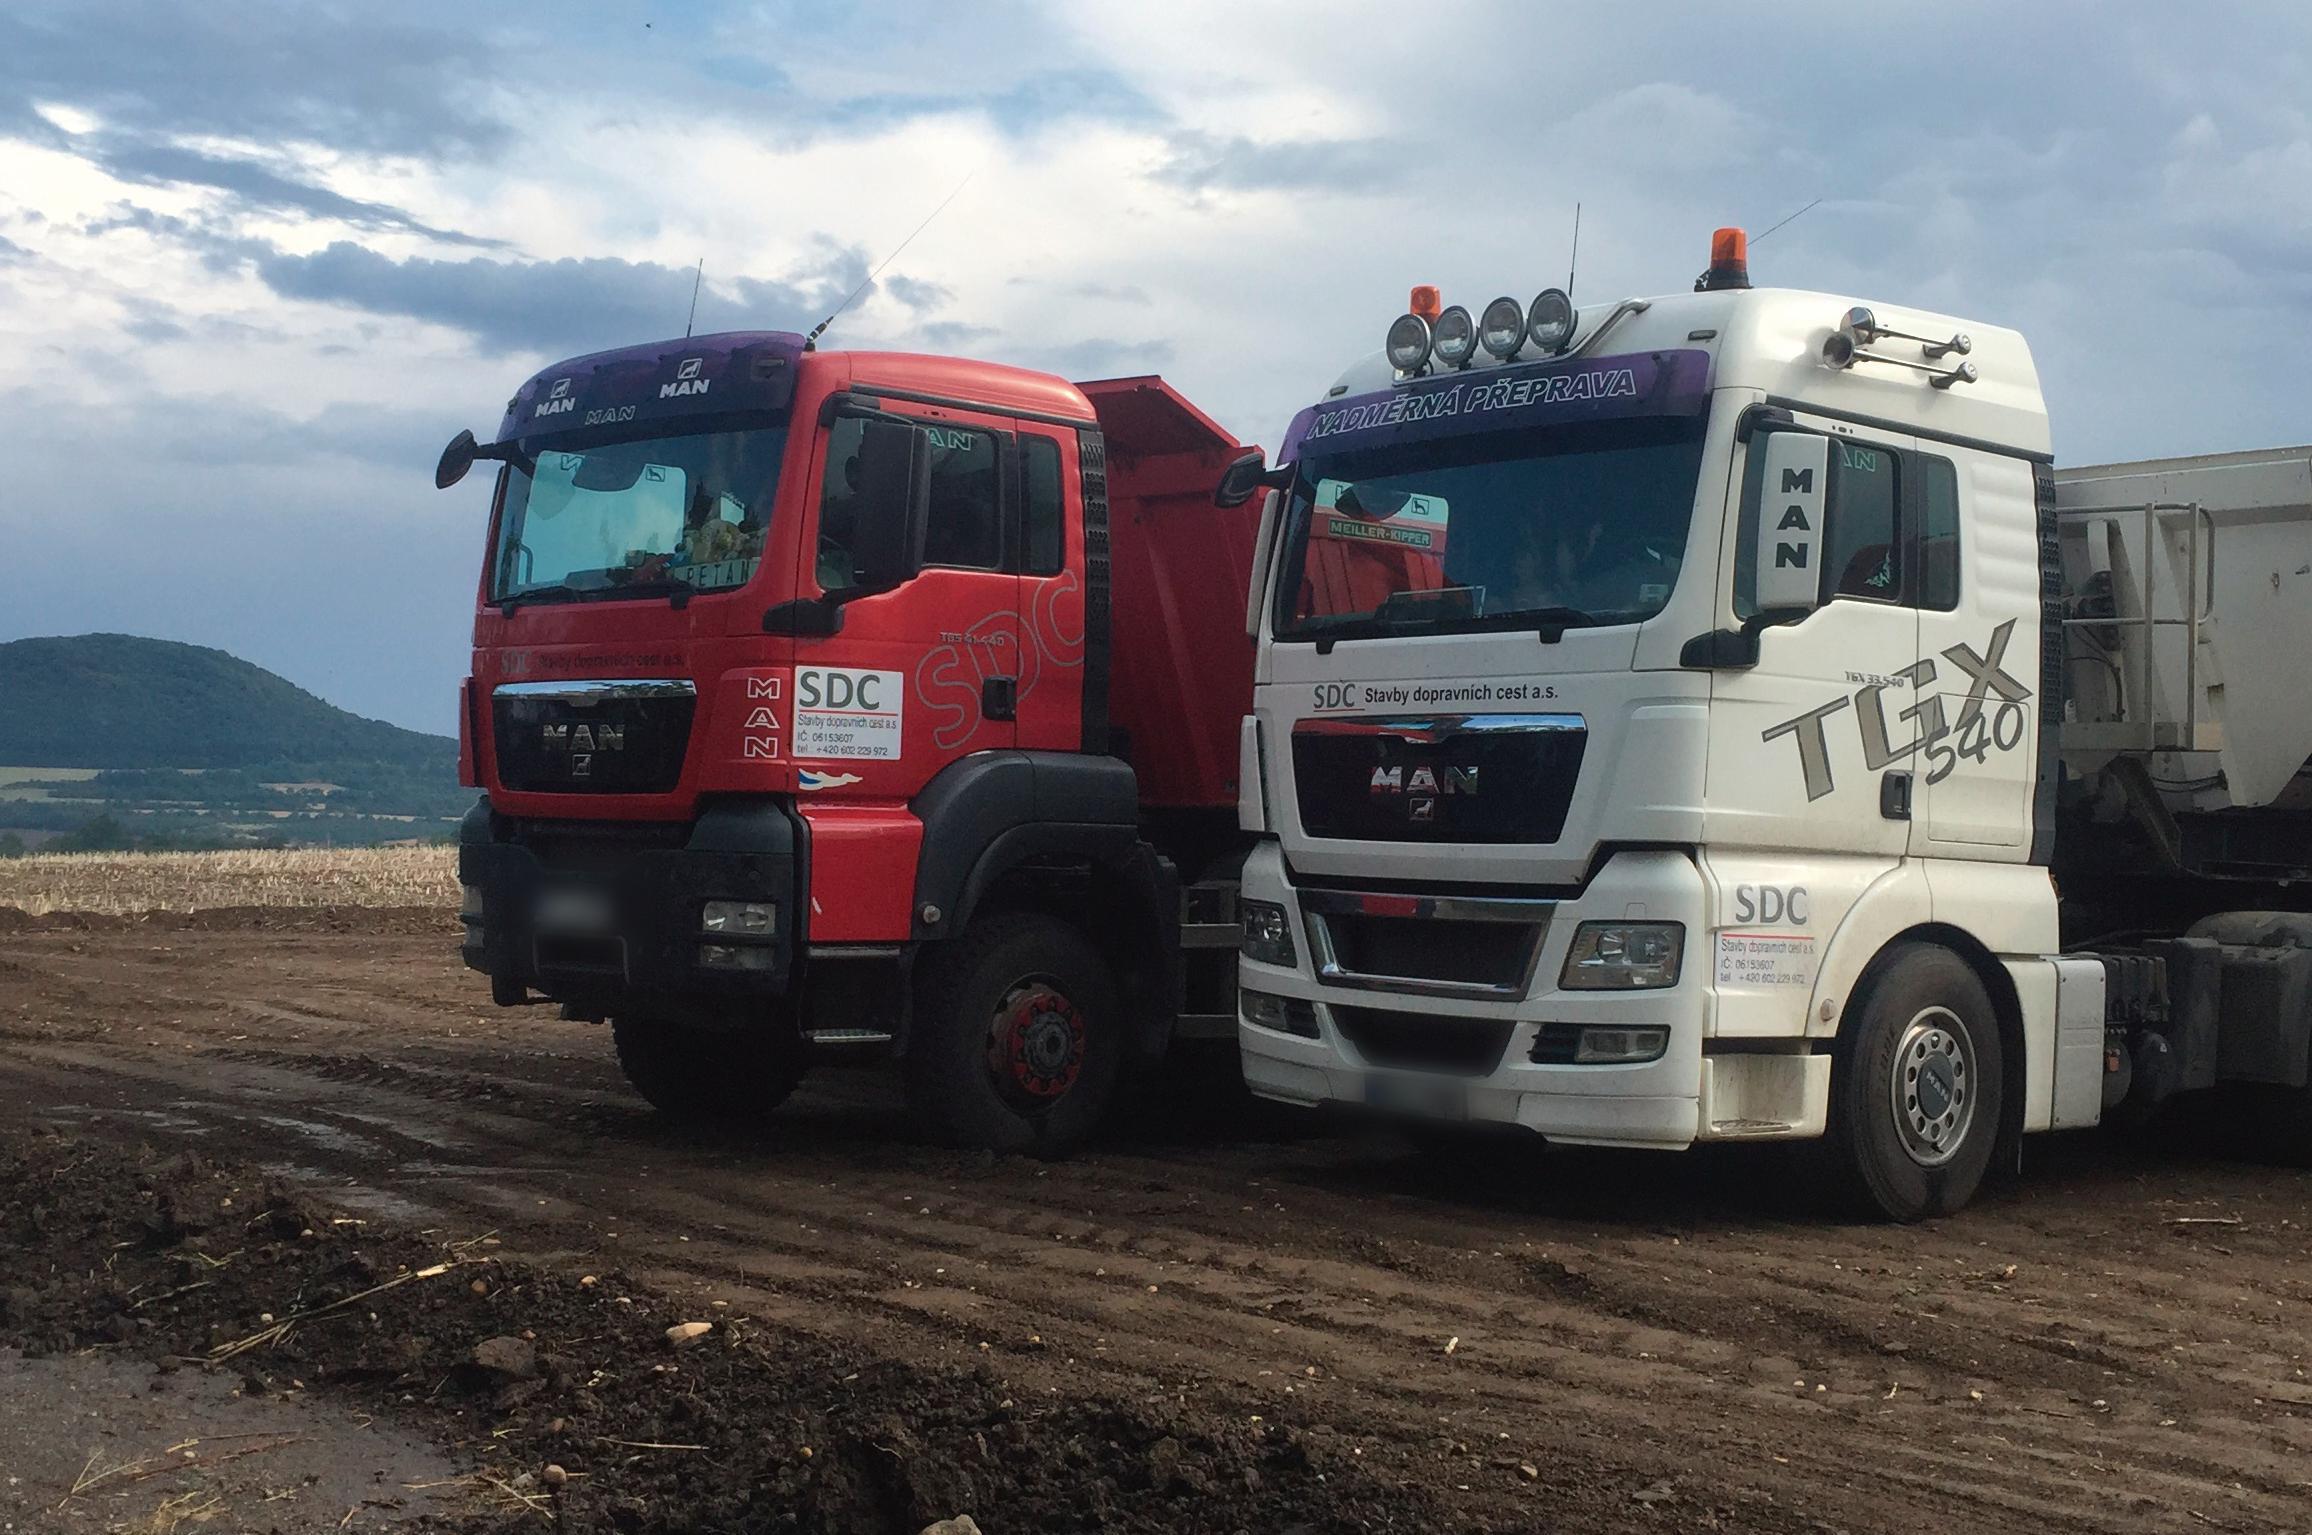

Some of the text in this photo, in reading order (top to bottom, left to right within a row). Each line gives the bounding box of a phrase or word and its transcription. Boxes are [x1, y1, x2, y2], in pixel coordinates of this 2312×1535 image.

[535, 398, 575, 418] MAN
[659, 379, 710, 398] MAN
[1306, 369, 1636, 440] NADMĚRNÁ PŘEPRAVA
[585, 405, 636, 425] MAN
[1775, 468, 1812, 568] MAN
[799, 671, 880, 710] SDC
[1313, 683, 1559, 709] SDC Stavby dopravních cest a.s.
[1761, 617, 2034, 802] TGX
[543, 724, 625, 750] MAN
[744, 677, 781, 758] MAN
[1924, 703, 2024, 786] 540
[1370, 766, 1479, 794] MAN
[1736, 884, 1807, 925] SDC
